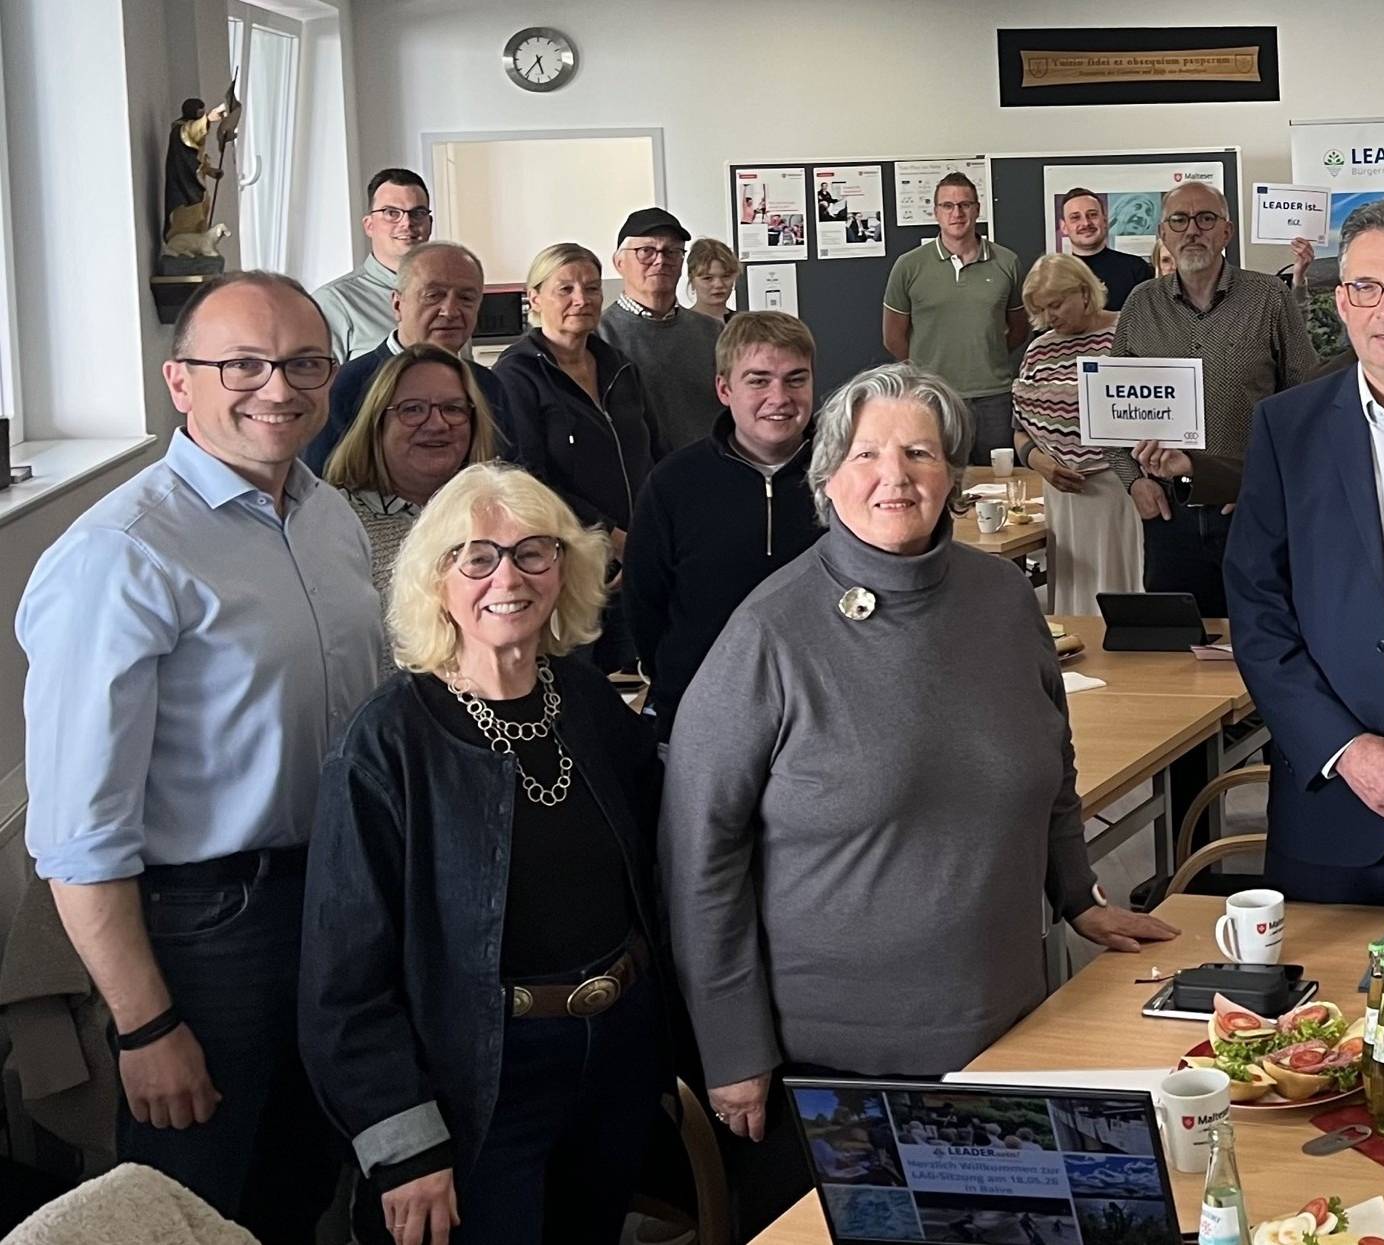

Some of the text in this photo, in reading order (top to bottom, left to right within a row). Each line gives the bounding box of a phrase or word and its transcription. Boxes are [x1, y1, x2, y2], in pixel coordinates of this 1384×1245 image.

[1263, 201, 1303, 210] LEADER
[1105, 384, 1176, 399] LEADER
[907, 1159, 957, 1170] Herzlich
[960, 1161, 1038, 1173] Willkommen
